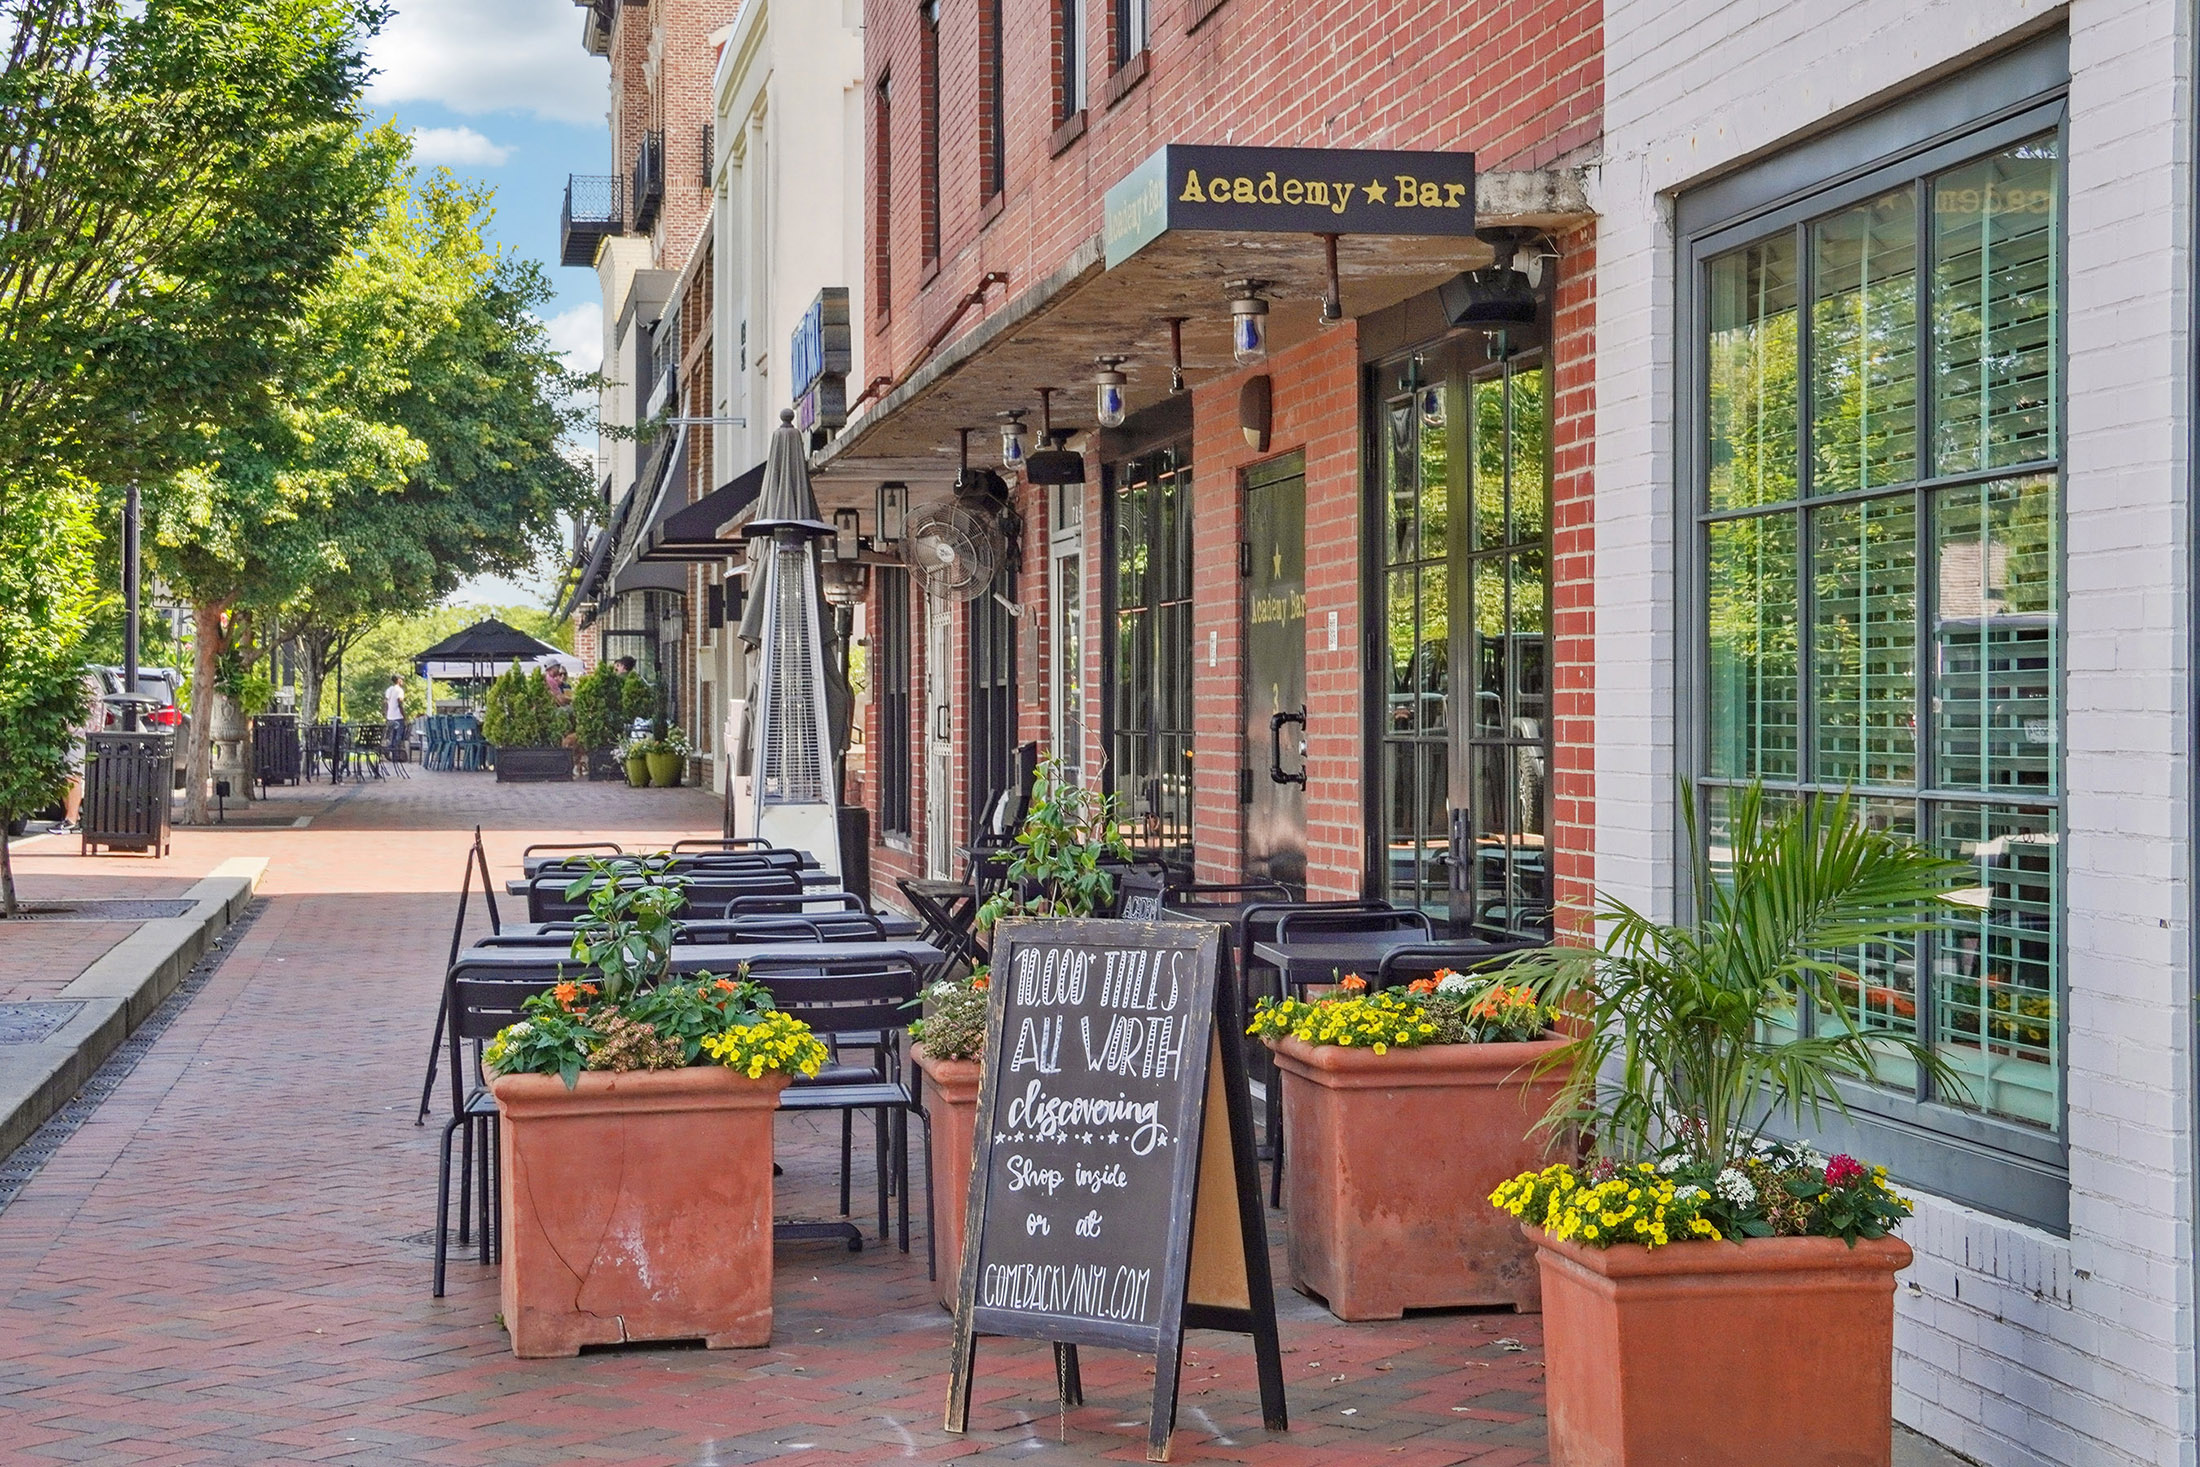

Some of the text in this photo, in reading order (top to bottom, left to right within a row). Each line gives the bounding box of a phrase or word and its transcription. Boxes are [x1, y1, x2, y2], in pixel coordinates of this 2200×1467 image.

[1179, 169, 1466, 214] Academy Bar
[1251, 593, 1287, 628] Academy
[1100, 950, 1183, 1012] TITLES
[1010, 1013, 1188, 1082] ALL WORTH
[1008, 1078, 1169, 1156] discovering
[1006, 1154, 1128, 1196] Shop inside
[1026, 1209, 1103, 1238] or at
[984, 1264, 1150, 1322] COMEBACKVINYL.COM
